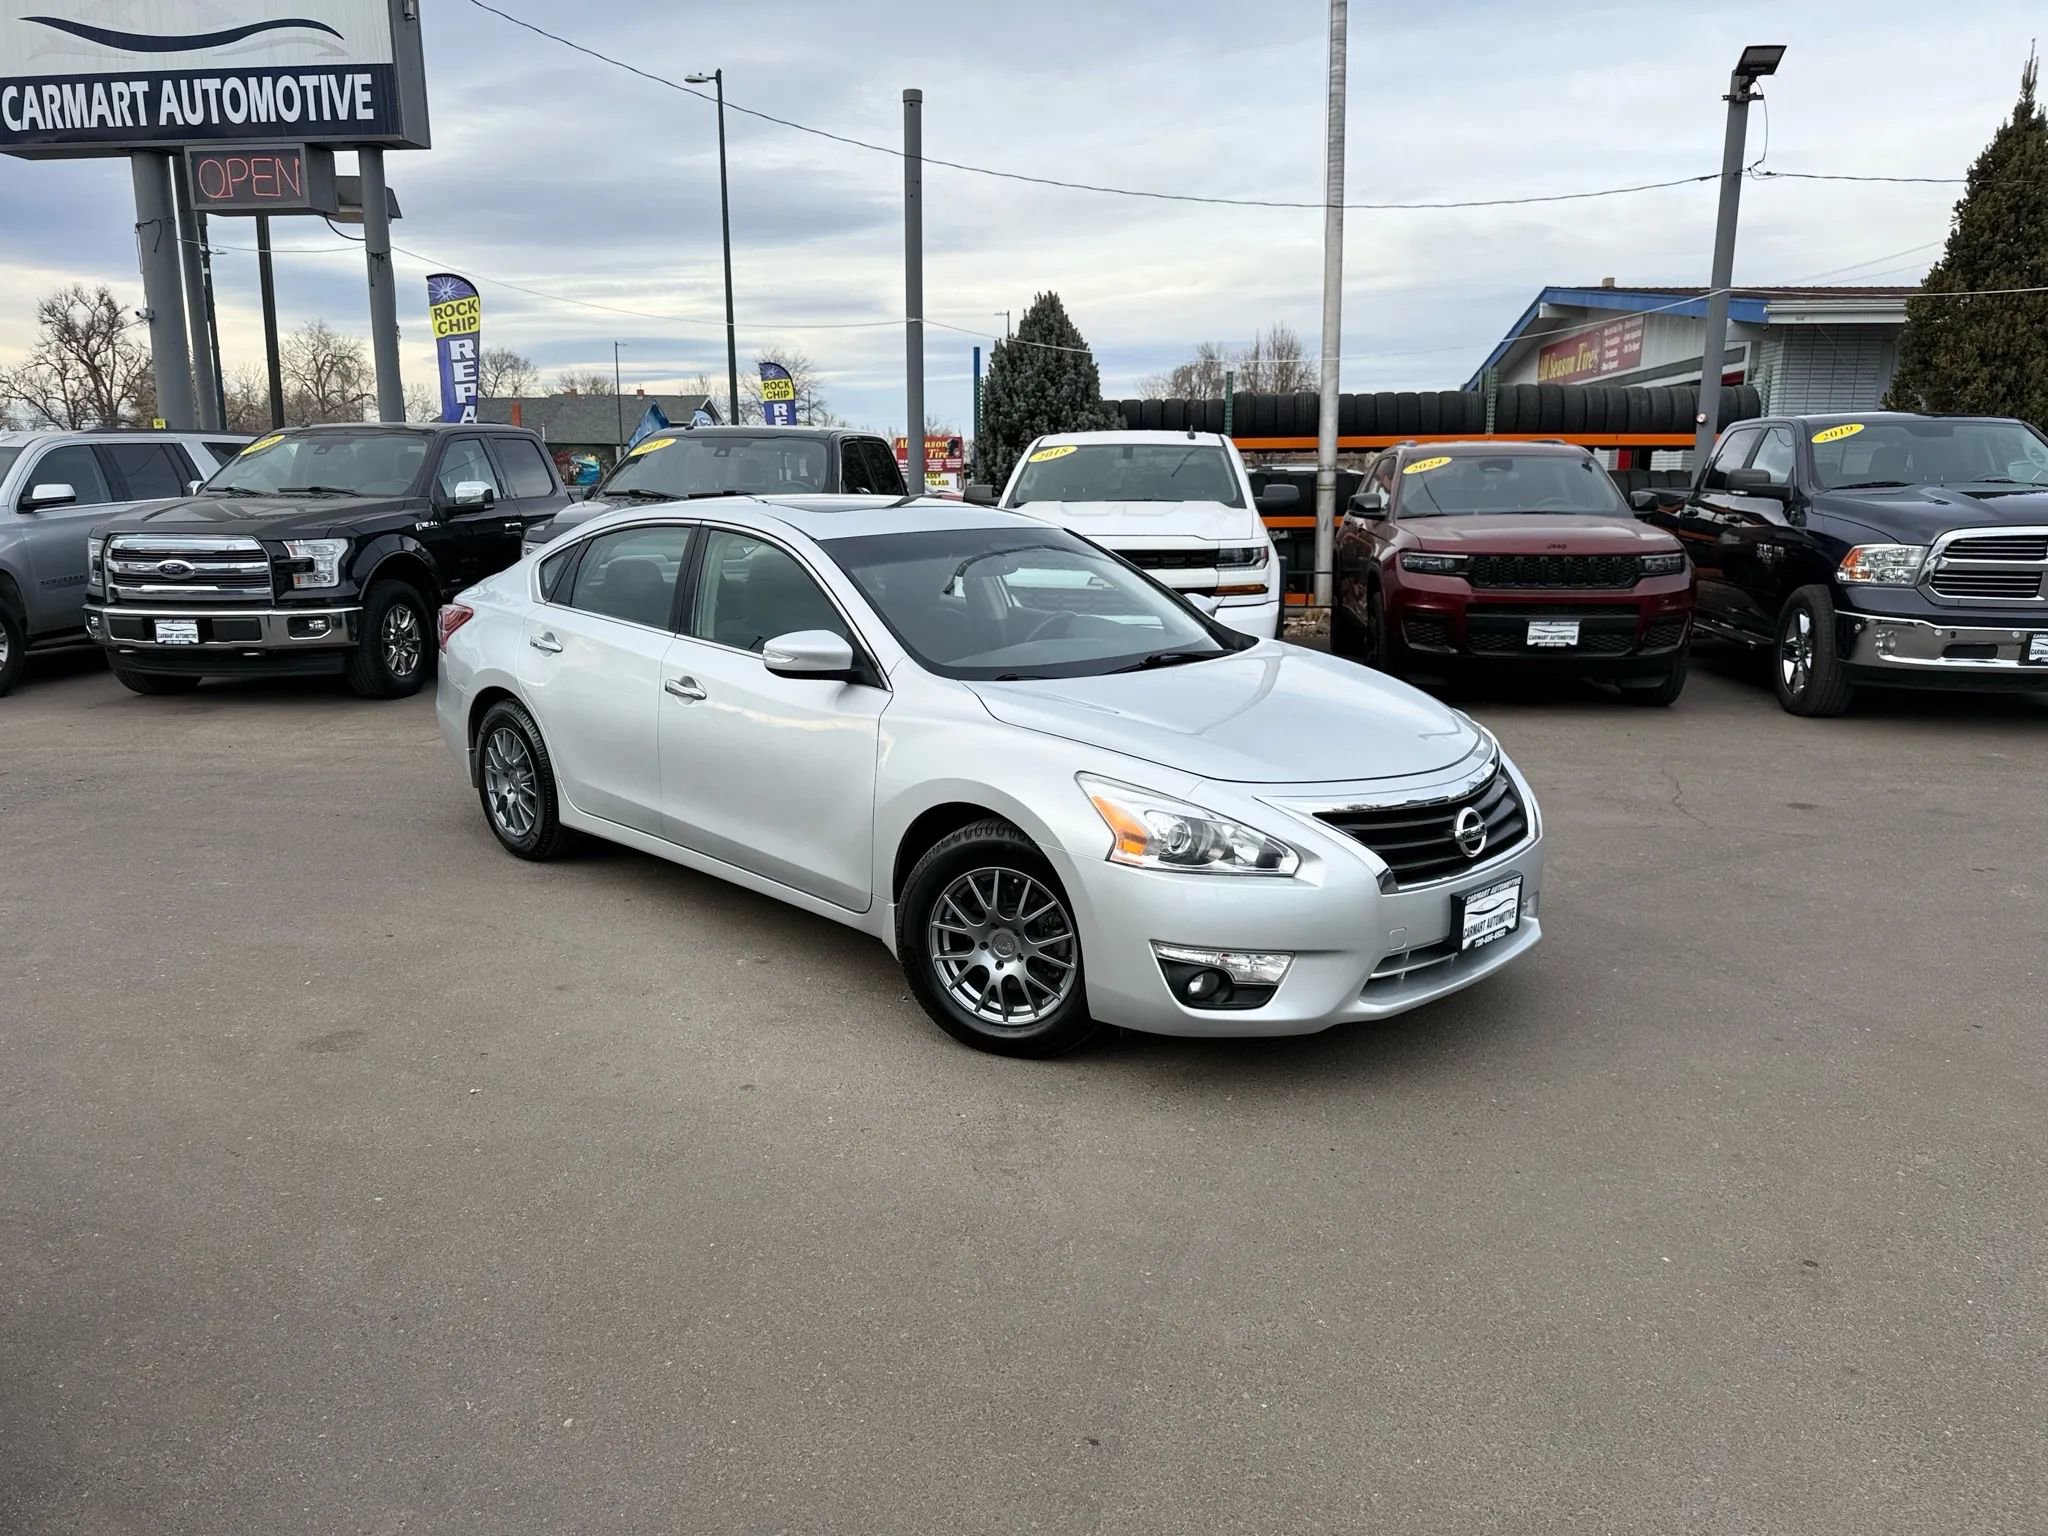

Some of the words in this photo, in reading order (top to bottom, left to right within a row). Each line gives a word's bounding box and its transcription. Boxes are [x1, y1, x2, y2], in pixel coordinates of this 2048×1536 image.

[1, 80, 149, 132] CARMART
[159, 73, 374, 126] AUTOMOTIVE
[199, 158, 302, 199] OPEN
[433, 300, 478, 321] ROCK
[437, 316, 477, 335] CHIP
[763, 380, 790, 391] ROCK
[766, 390, 790, 400] CHIP
[1823, 425, 1854, 441] 2019
[1037, 447, 1069, 460] 2018
[1408, 458, 1442, 472] 2024
[1466, 888, 1491, 906] CARMART
[1490, 876, 1523, 893] AUTOMOTIVE
[1463, 919, 1487, 938] CARMART
[1486, 906, 1516, 929] AUTOMOTIVE
